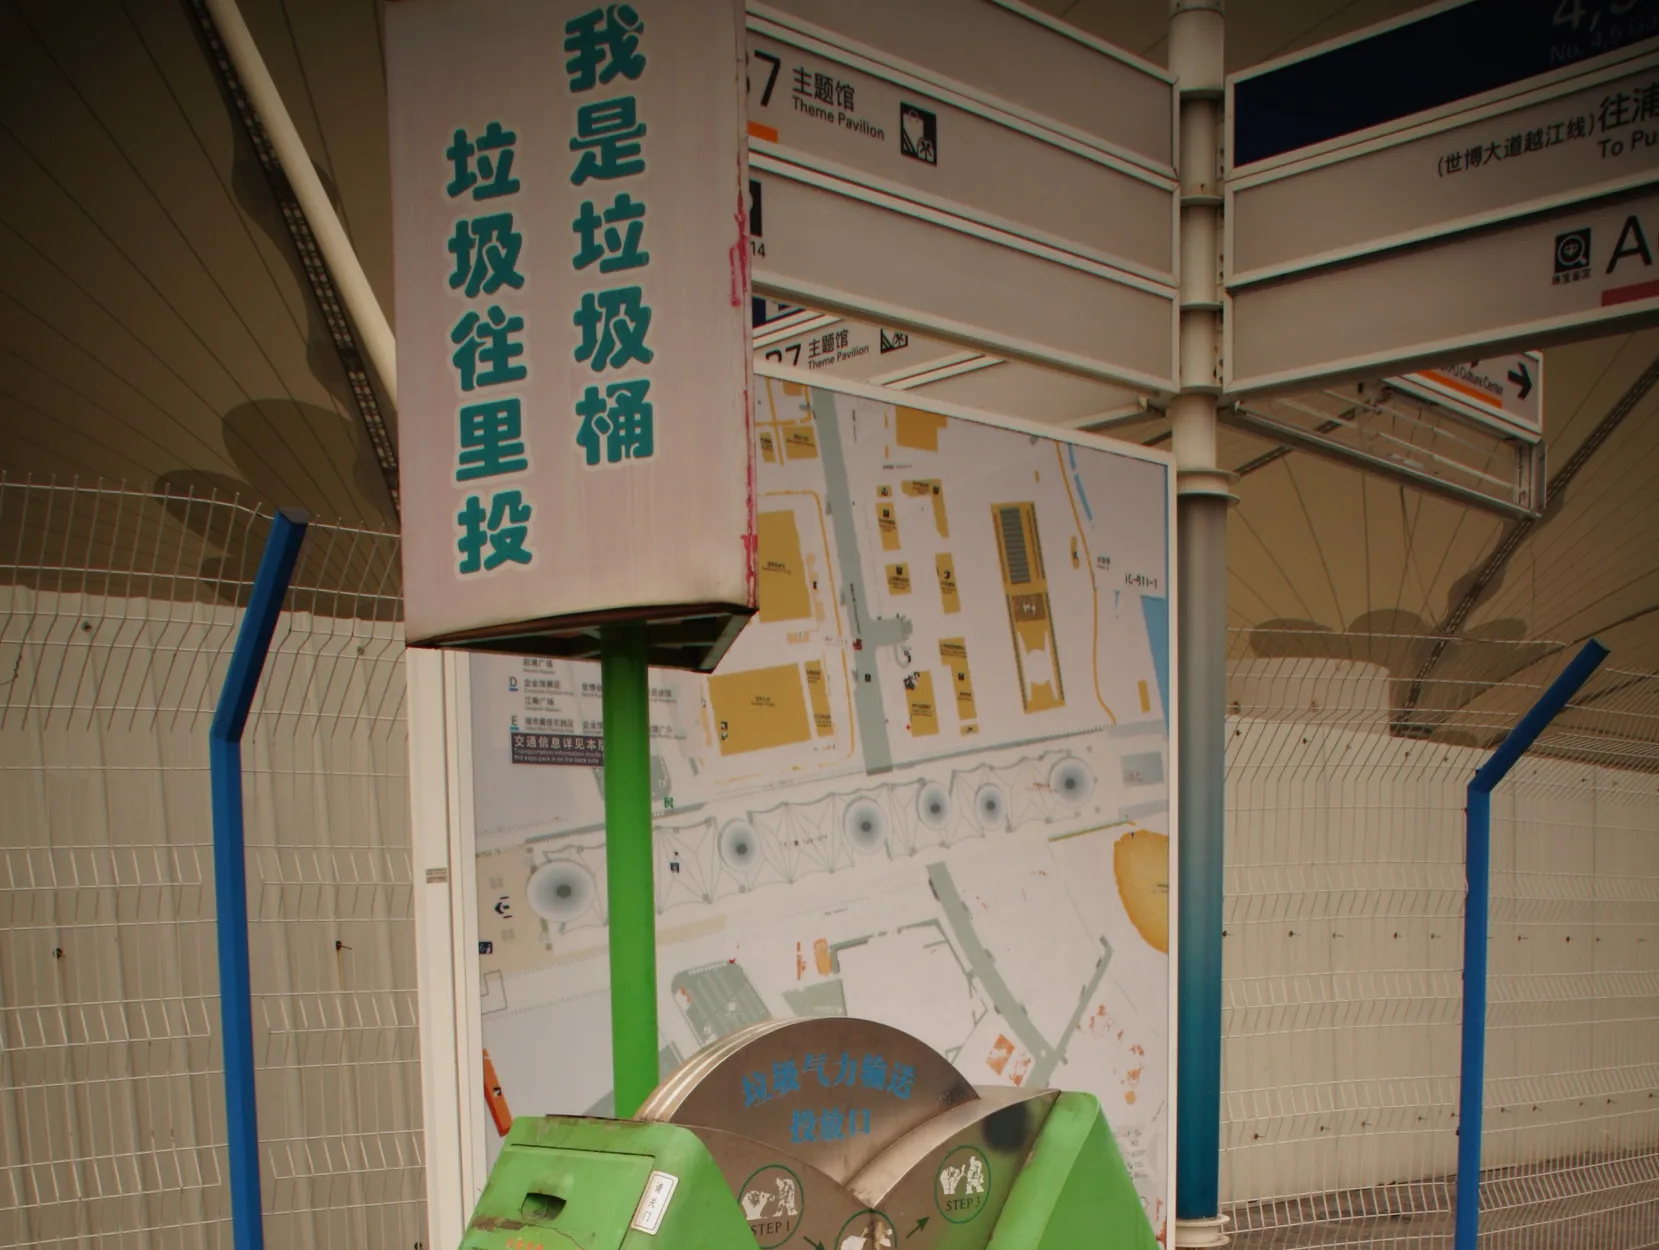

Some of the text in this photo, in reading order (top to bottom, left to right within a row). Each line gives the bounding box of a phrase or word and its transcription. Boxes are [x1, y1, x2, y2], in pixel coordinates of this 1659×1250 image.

[746, 49, 781, 108] 7
[792, 65, 856, 112] 主题馆
[792, 95, 886, 142] Theme Pavilion
[1597, 137, 1624, 160] To
[563, 3, 656, 468] 我是垃圾桶
[445, 121, 534, 574] 垃圾往里投
[808, 328, 849, 359] 主题馆
[808, 344, 870, 371] Theme Pavilion
[509, 676, 518, 687] D
[741, 1050, 916, 1108] 垃圾气力输送
[789, 1106, 873, 1145] 投放口
[946, 1196, 982, 1213] STEP 3
[751, 1221, 782, 1237] STEP
